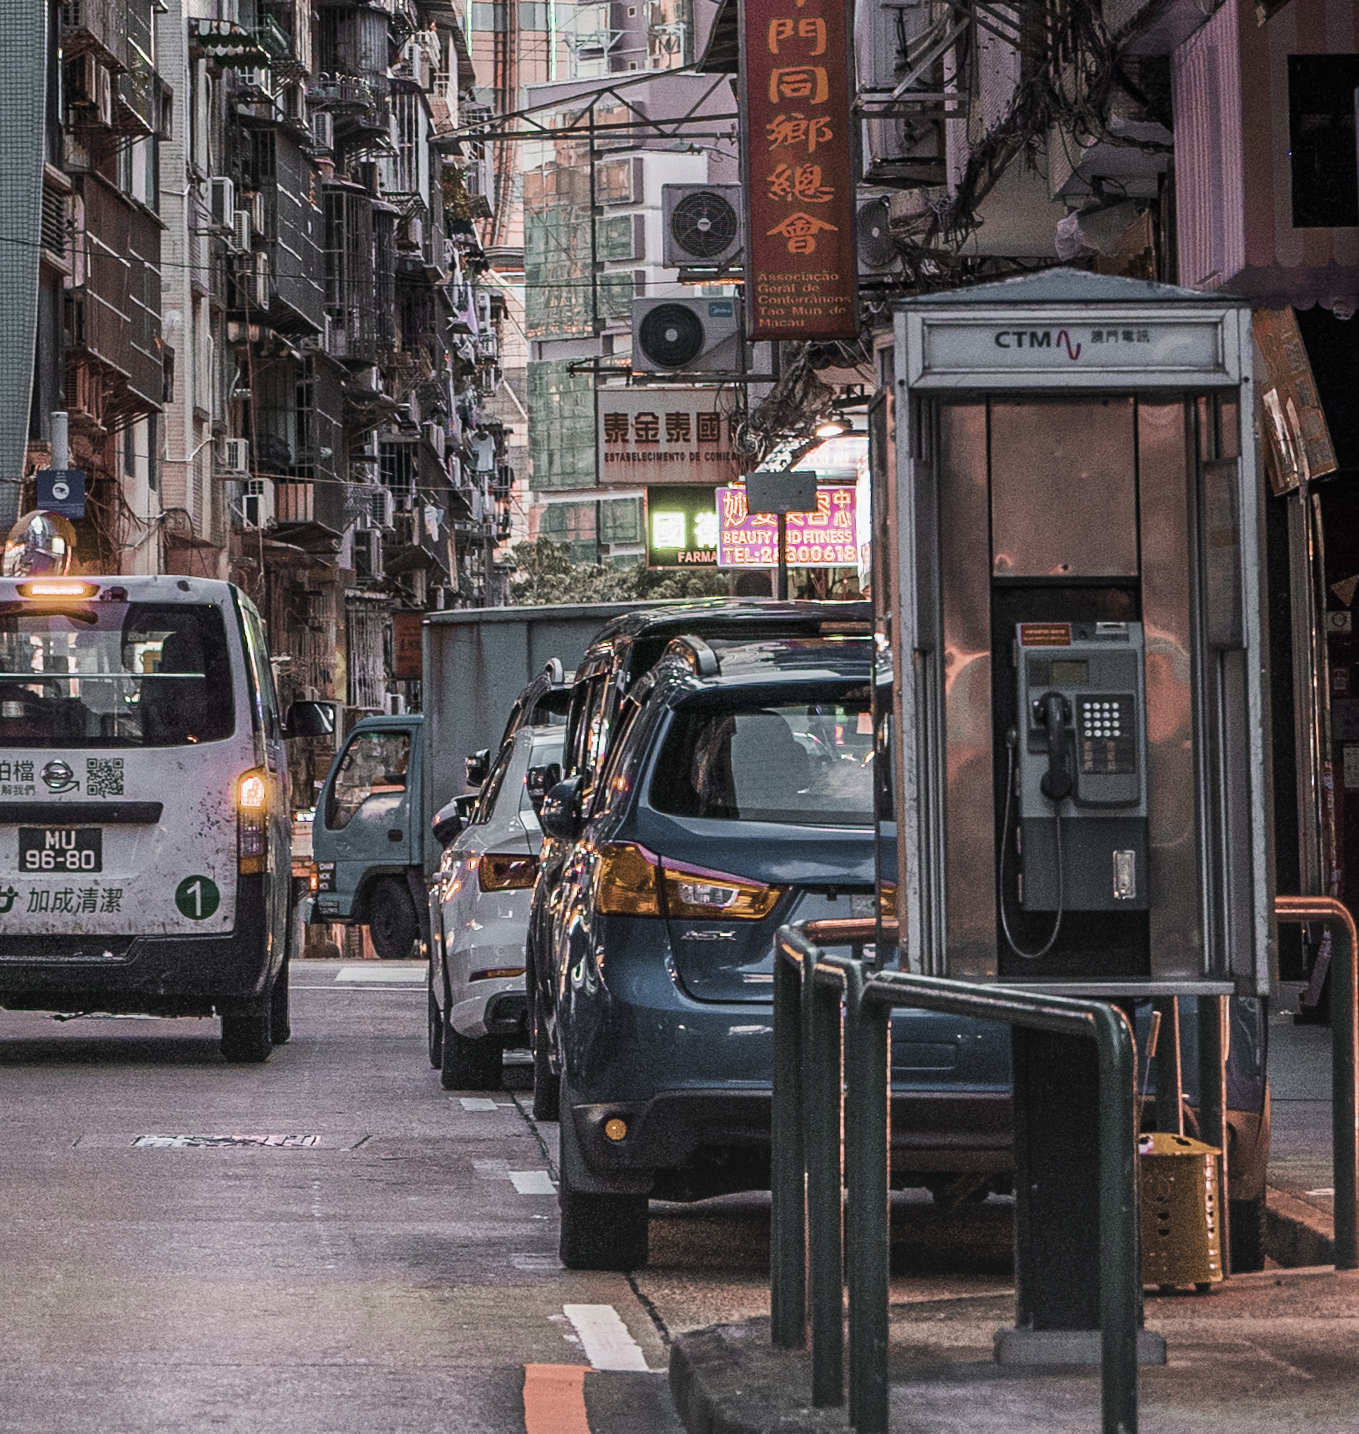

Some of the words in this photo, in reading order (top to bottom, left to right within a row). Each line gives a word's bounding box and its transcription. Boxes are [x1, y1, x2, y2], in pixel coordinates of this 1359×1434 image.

[759, 270, 839, 281] Associação
[758, 284, 795, 292] Geral
[803, 284, 820, 292] de
[792, 307, 822, 315] Mun
[759, 319, 805, 327] Macau
[995, 331, 1051, 348] CTM
[604, 412, 736, 443] 泰金泰國
[605, 452, 685, 462] ESTABELECIMENTO
[689, 452, 700, 461] DE
[722, 531, 771, 544] BEAUTY
[803, 530, 853, 544] FITNESS
[45, 831, 76, 849] MU
[25, 850, 95, 870] 96-80
[26, 887, 123, 914] 加成清潔
[186, 880, 203, 917] 1
